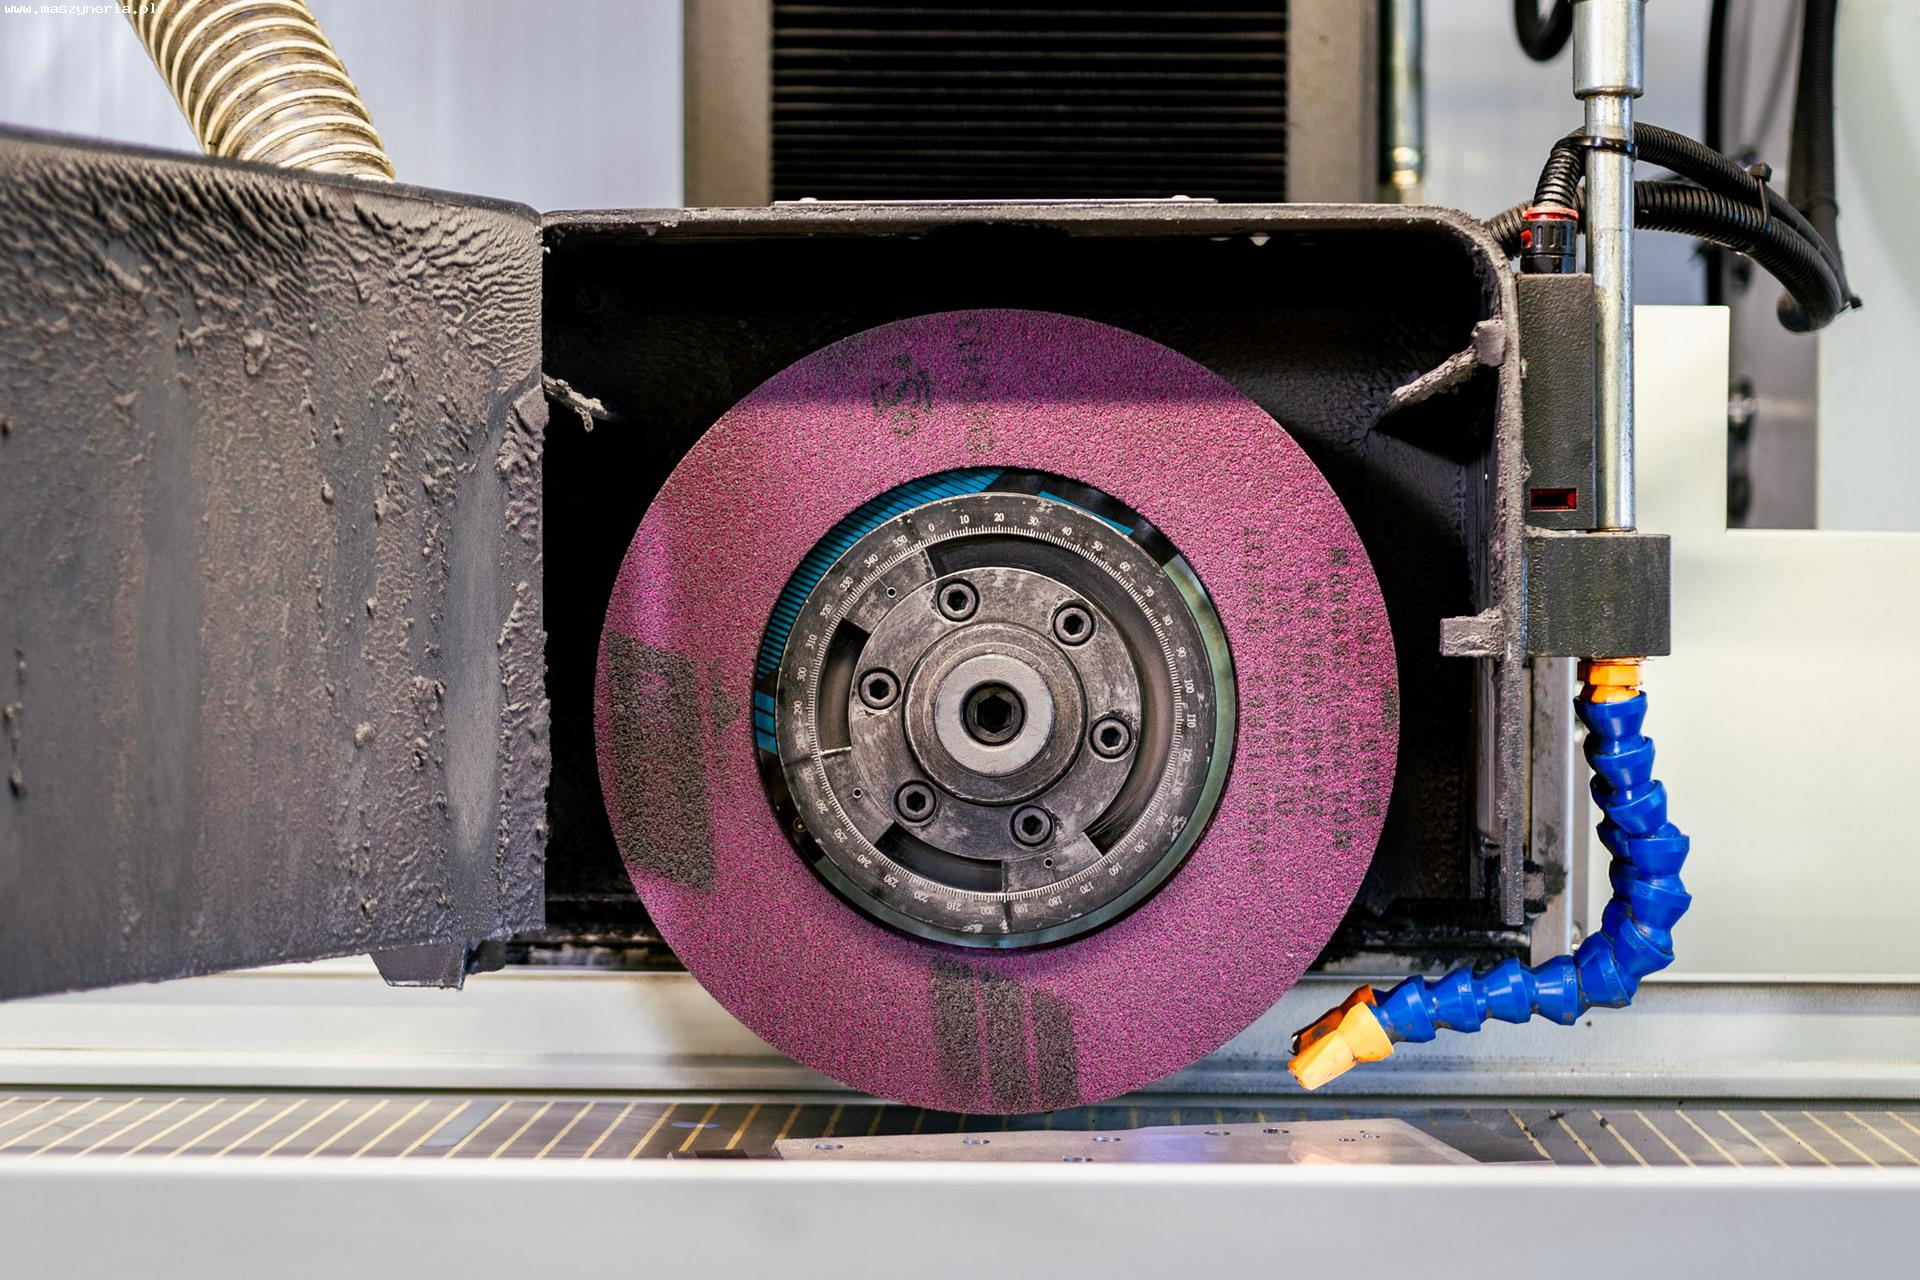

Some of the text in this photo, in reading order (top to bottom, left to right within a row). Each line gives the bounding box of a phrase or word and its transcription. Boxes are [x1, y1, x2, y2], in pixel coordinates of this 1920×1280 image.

[960, 514, 970, 524] 10
[993, 512, 1005, 522] 20
[1027, 515, 1039, 526] 30
[928, 523, 935, 532] 0
[1061, 526, 1073, 536] 40
[892, 534, 908, 548] 350
[1091, 540, 1103, 551] 50
[863, 553, 879, 568] 340
[1119, 561, 1131, 572] 60
[839, 576, 854, 592] 330
[1143, 585, 1155, 598] 70
[819, 603, 833, 619] 320
[1162, 614, 1173, 626] 80
[805, 634, 818, 650] 310
[1176, 646, 1186, 658] 90
[796, 666, 807, 682] 300
[1184, 678, 1195, 694] 100
[1187, 713, 1197, 728] 110
[833, 827, 848, 843] 250
[1134, 838, 1148, 854] 150
[857, 853, 873, 869] 240
[1109, 863, 1124, 876] 160
[883, 874, 900, 888] 230
[1079, 882, 1095, 895] 170
[913, 889, 929, 903] 220
[1047, 894, 1063, 908] 180
[946, 901, 962, 912] 210
[1014, 903, 1029, 914] 190
